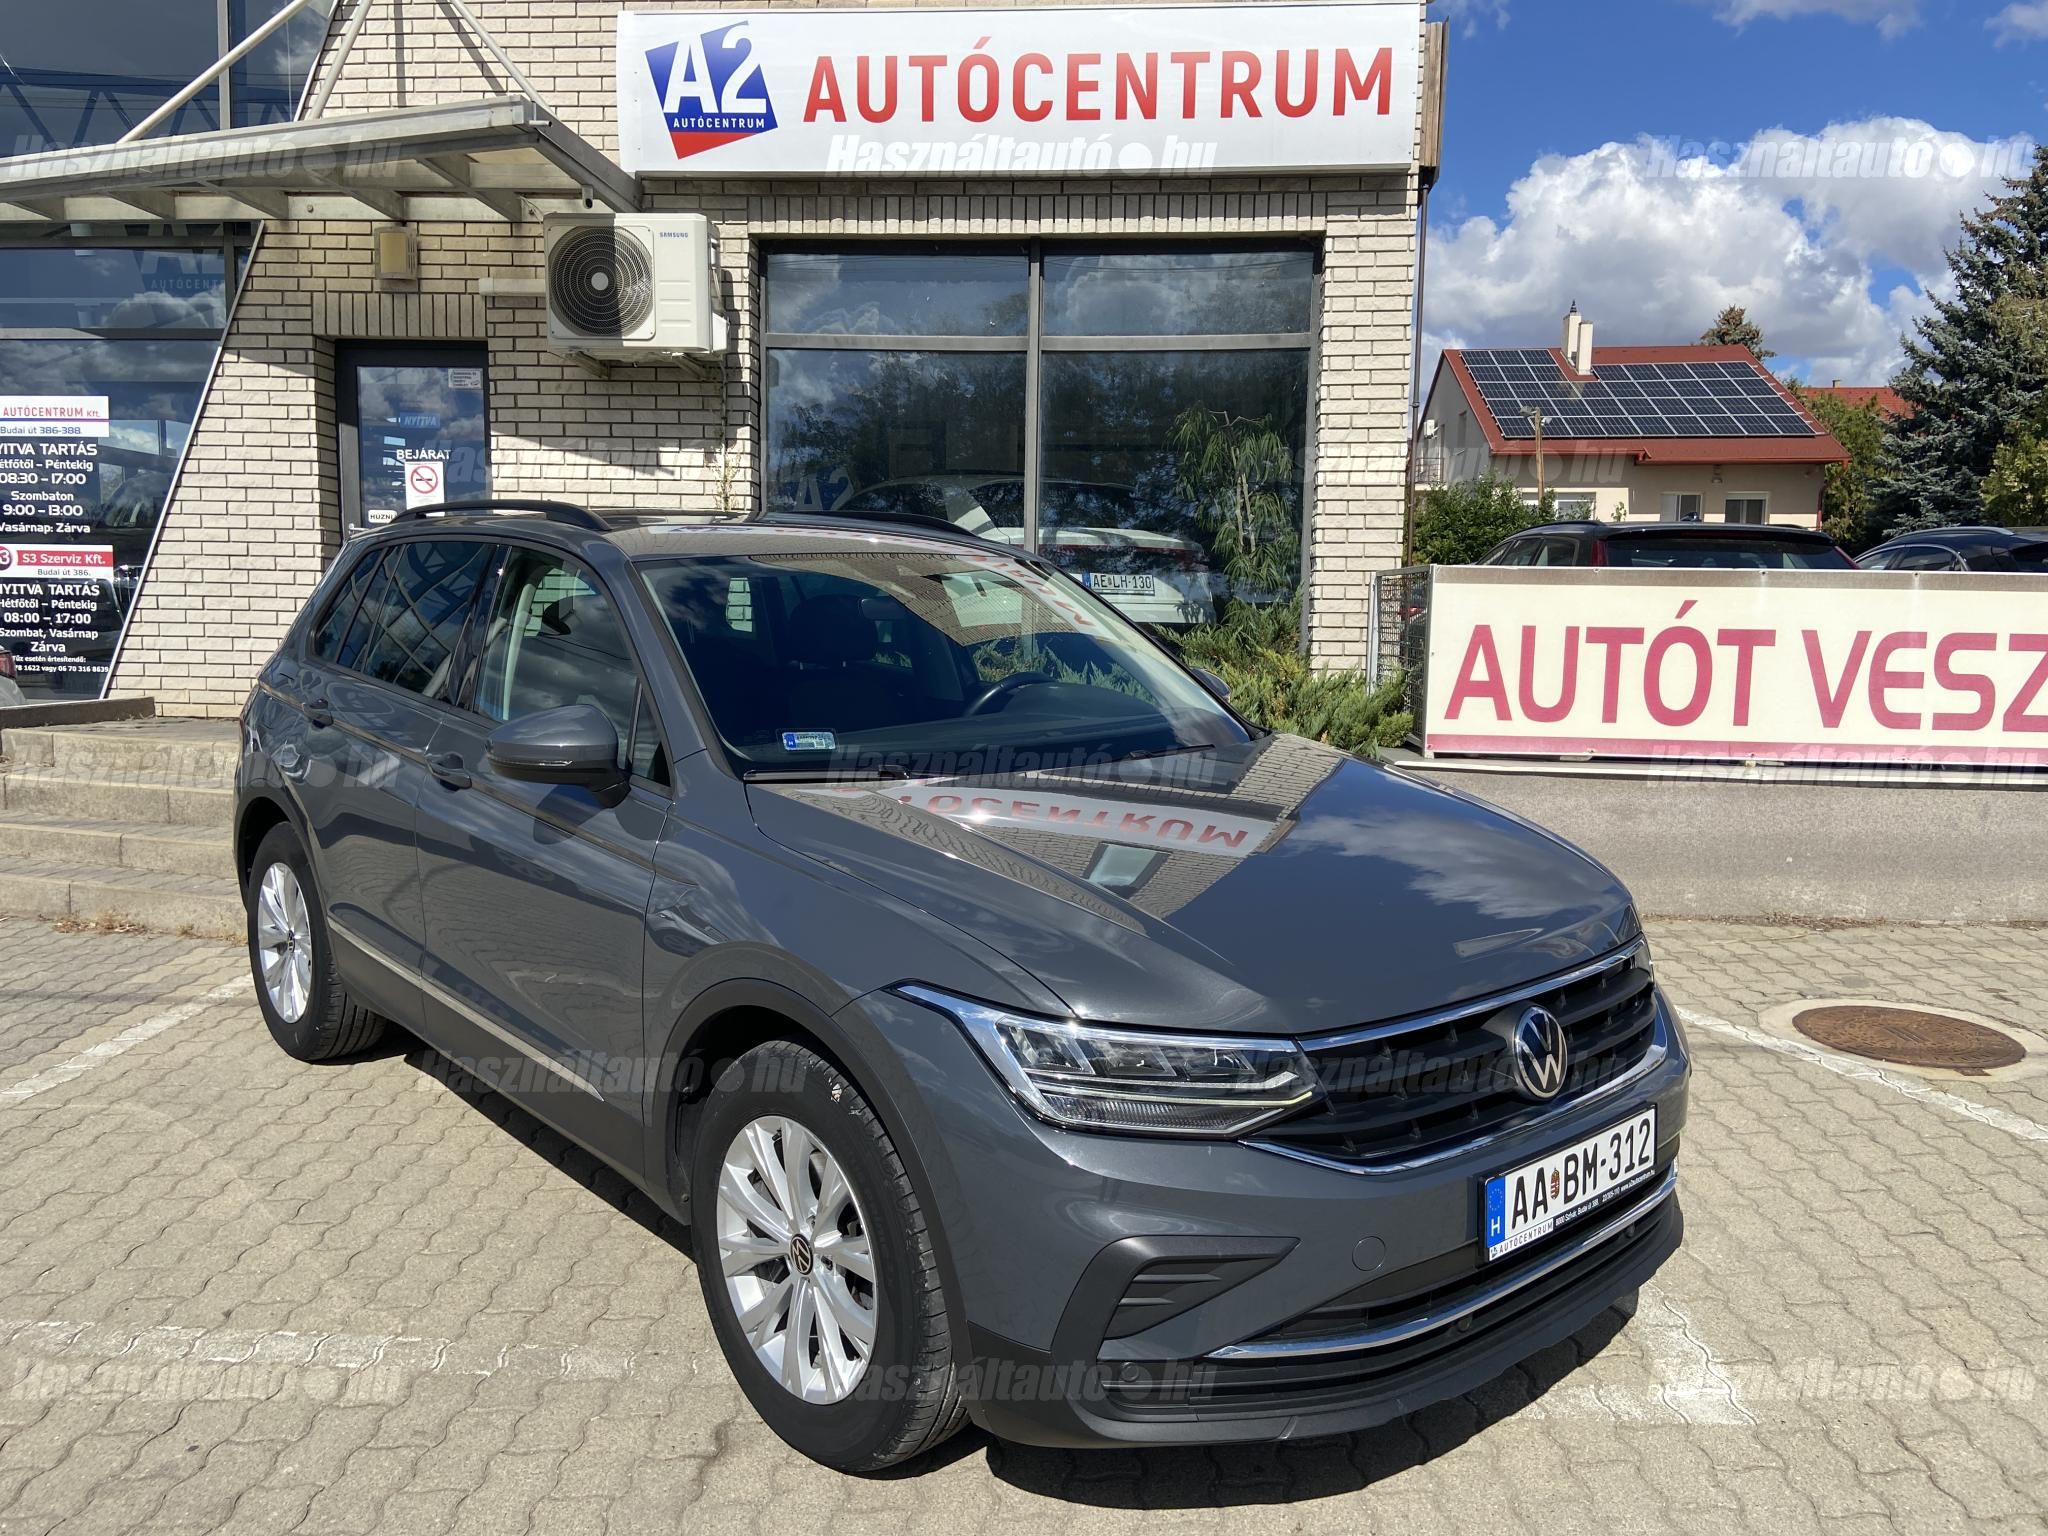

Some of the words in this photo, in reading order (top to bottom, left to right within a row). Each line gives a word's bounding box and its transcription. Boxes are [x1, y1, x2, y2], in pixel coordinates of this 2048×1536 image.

[663, 22, 767, 113] A2
[803, 36, 1393, 124] AUTÓCENTRUM
[673, 115, 765, 128] AUTÓCENTRUM
[3, 405, 83, 417] AUTÓCENTRUM
[404, 415, 437, 426] NYITVA
[0, 426, 25, 434] Budai
[40, 440, 98, 456] TARTÁS
[396, 447, 452, 460] BEJÁRAT
[46, 459, 94, 472] Péntekig
[0, 472, 38, 484] 08:30
[52, 472, 86, 484] 17:00
[10, 490, 74, 501] Szombaton
[48, 504, 84, 516] 13:00
[56, 522, 90, 533] Zárva
[22, 554, 36, 563] S3
[40, 554, 82, 564] Szerviz
[85, 554, 106, 564] Kft.
[1094, 574, 1108, 588] AE
[1112, 575, 1152, 588] LH-130
[48, 581, 100, 596] TARTÁS
[51, 598, 98, 611] Péntekig
[4, 612, 40, 624] 08:00
[56, 612, 92, 624] 17:00
[0, 628, 46, 639] Szombat,
[49, 628, 98, 640] Vasárnap
[30, 640, 66, 652] Zárva
[1443, 599, 1777, 728] AUTÓT
[1511, 1167, 1548, 1230] AA
[1563, 1118, 1651, 1205] BM-312
